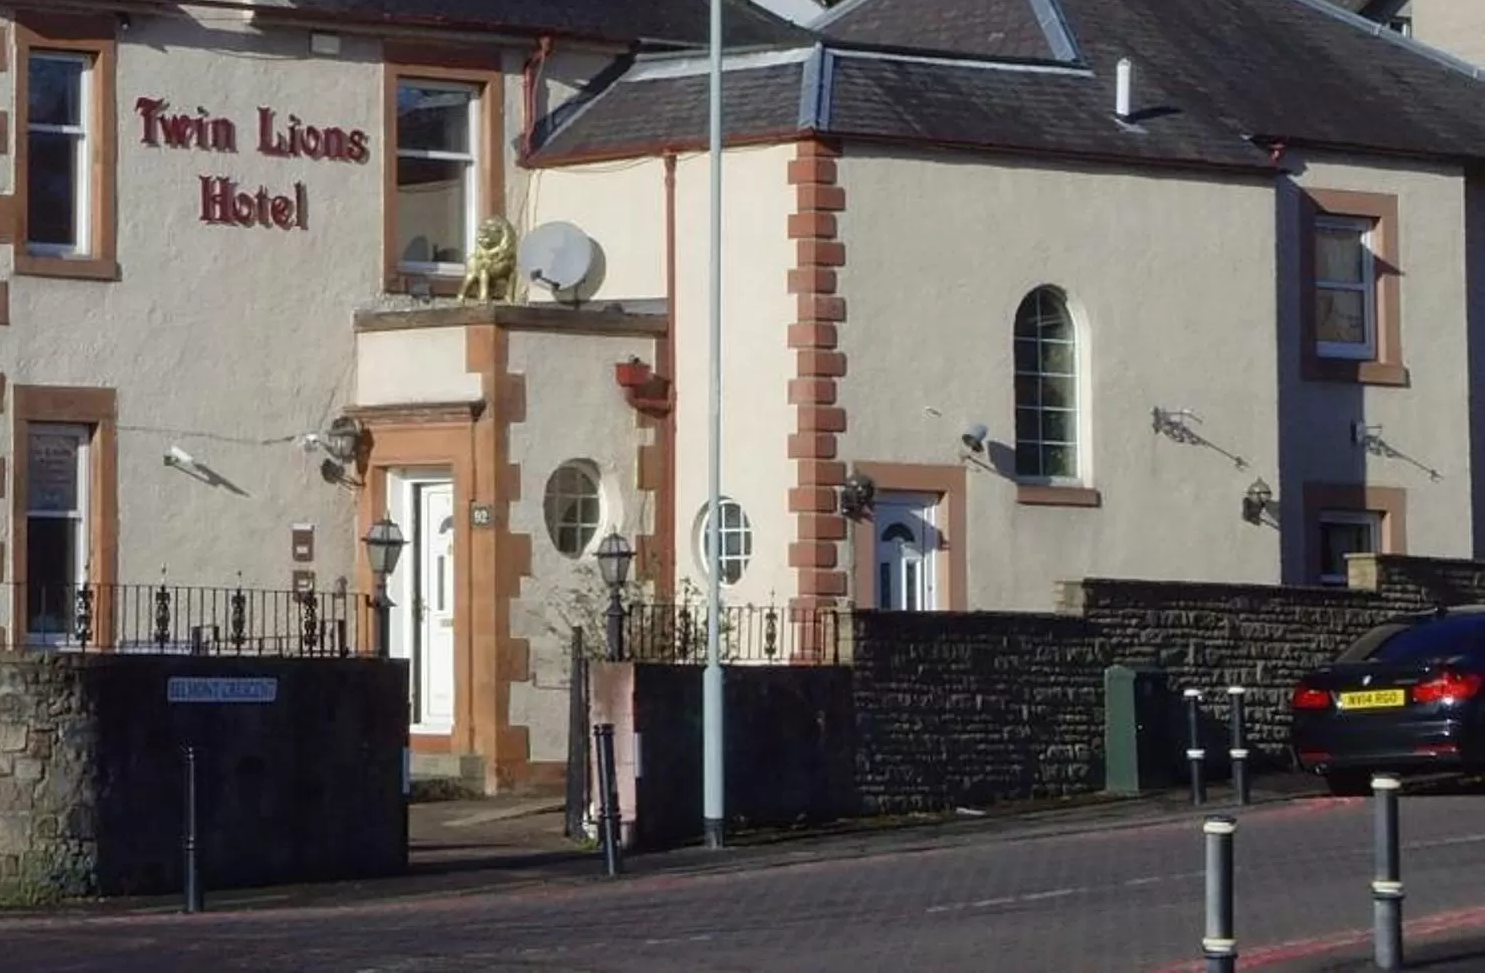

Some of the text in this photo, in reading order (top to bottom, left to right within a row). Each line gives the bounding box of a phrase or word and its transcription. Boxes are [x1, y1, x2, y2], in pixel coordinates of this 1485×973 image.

[135, 97, 371, 165] Twin Lions
[199, 175, 309, 231] Hotel
